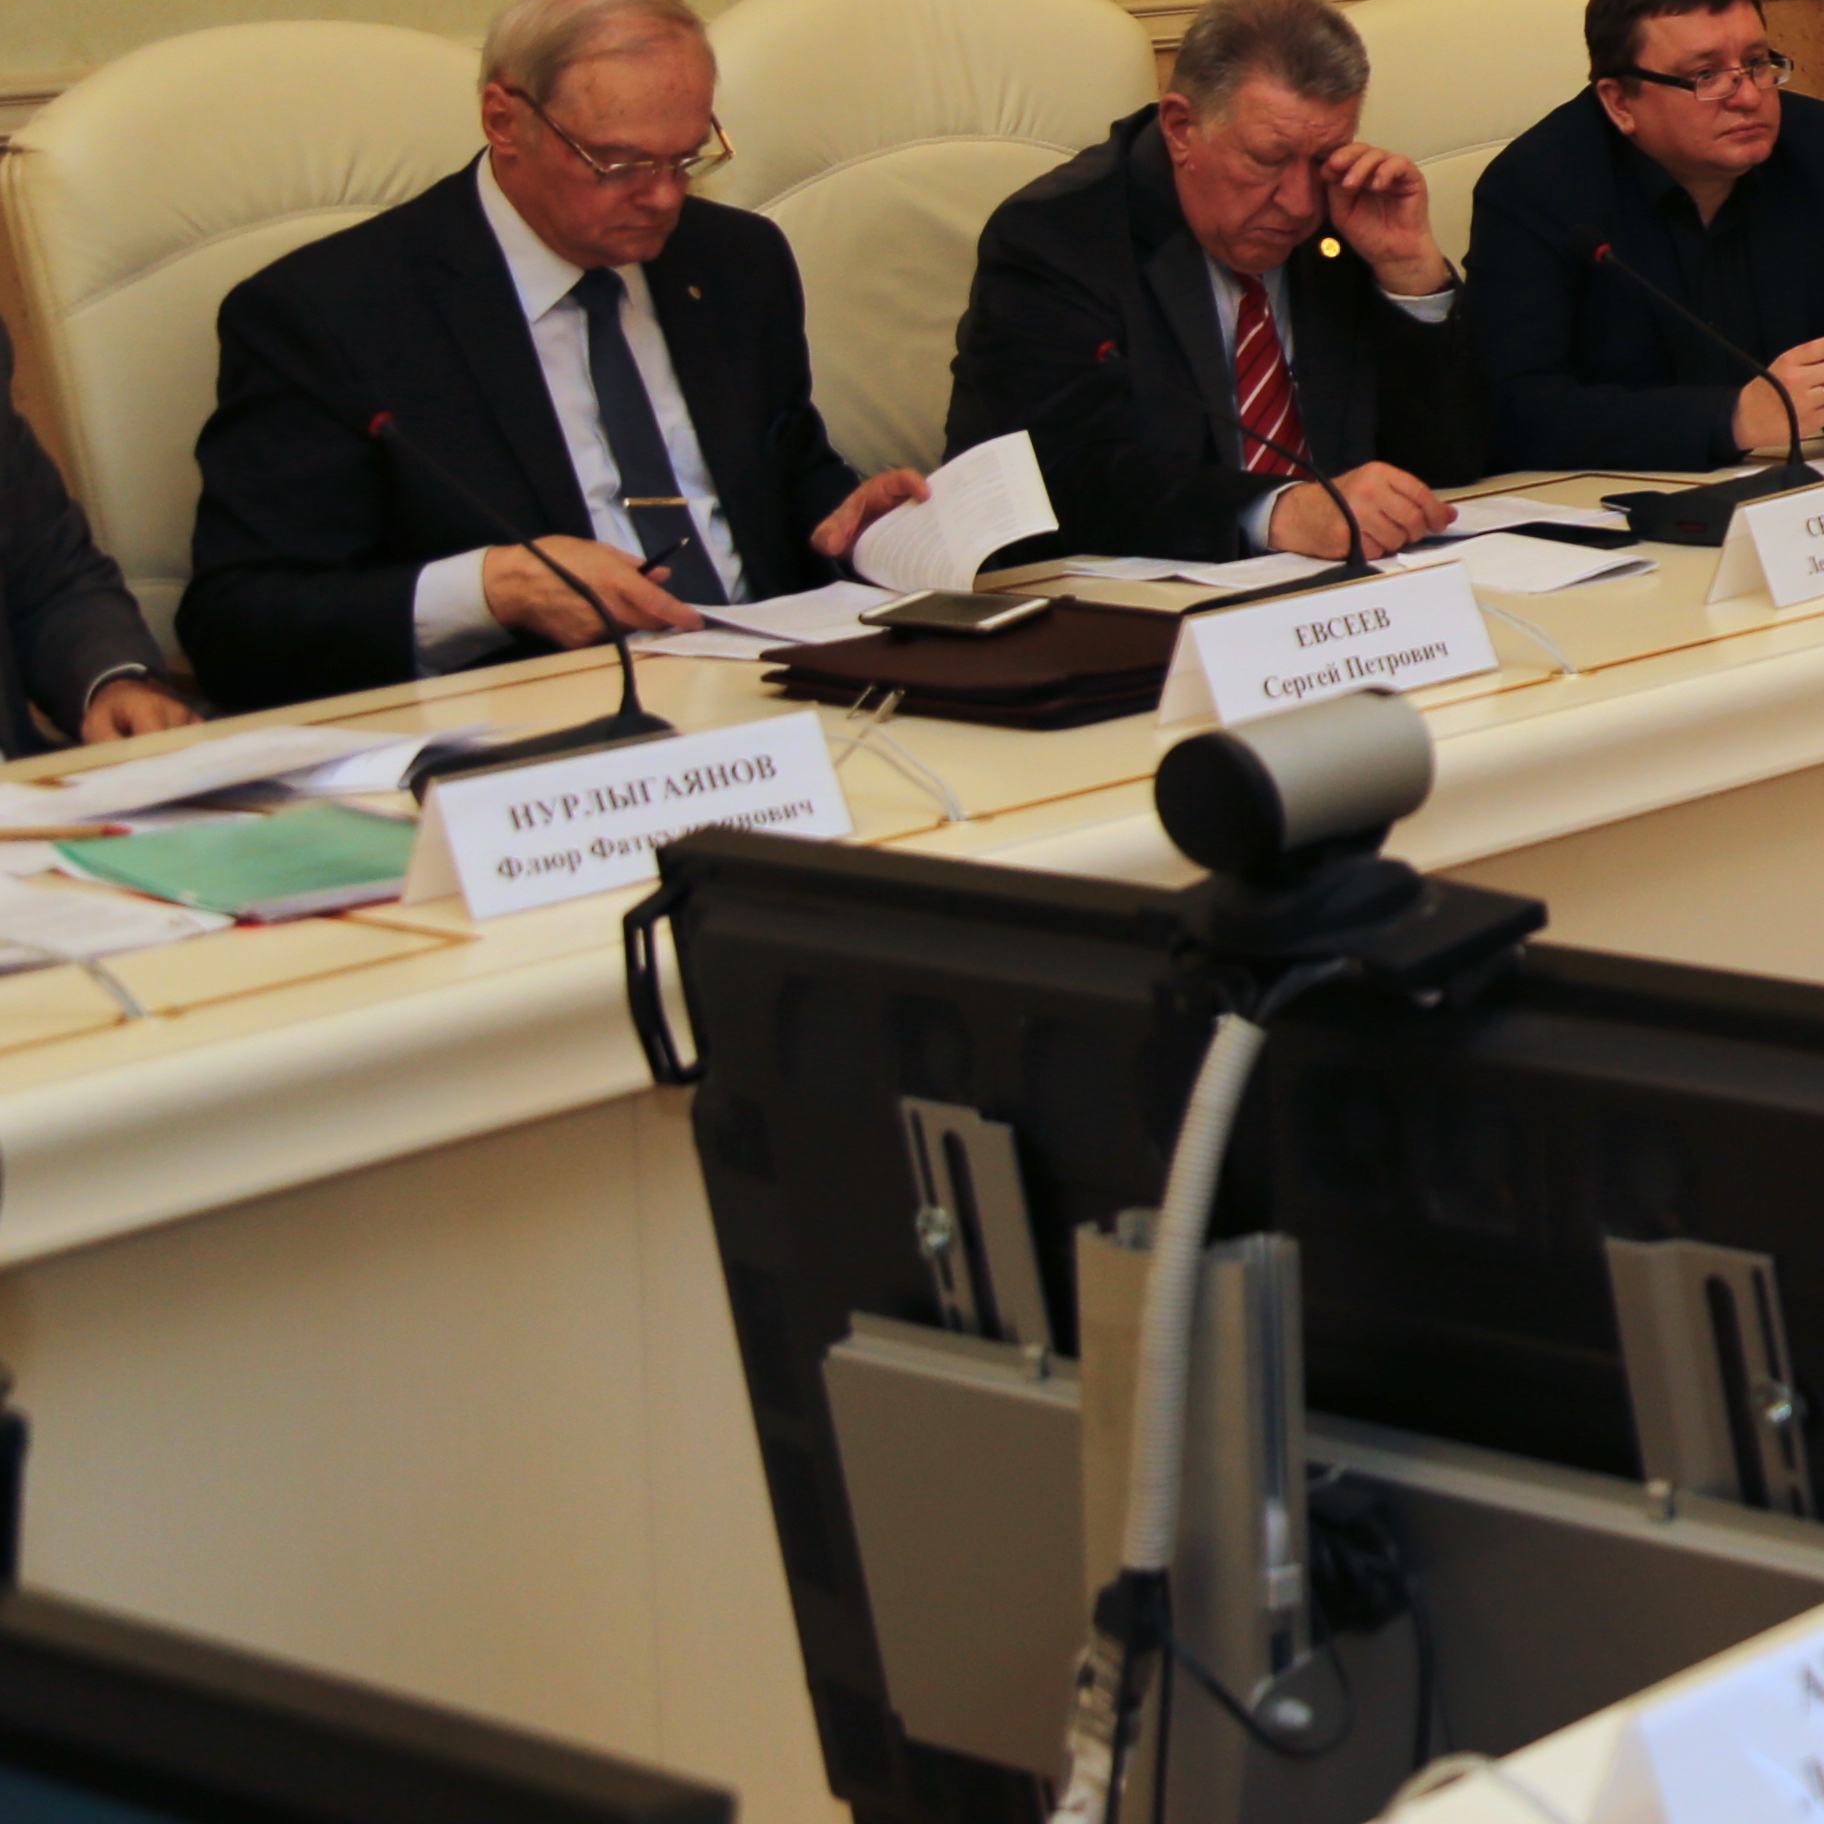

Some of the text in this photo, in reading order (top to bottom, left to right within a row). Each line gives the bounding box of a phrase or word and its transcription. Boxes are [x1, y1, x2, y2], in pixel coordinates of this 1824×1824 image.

[1293, 606, 1391, 648] ЕВСЕЕВ
[1263, 640, 1449, 698] Сергей Петрович
[508, 753, 778, 832] НУРЛЫГАЯНОВ
[497, 848, 583, 880] Флюр
